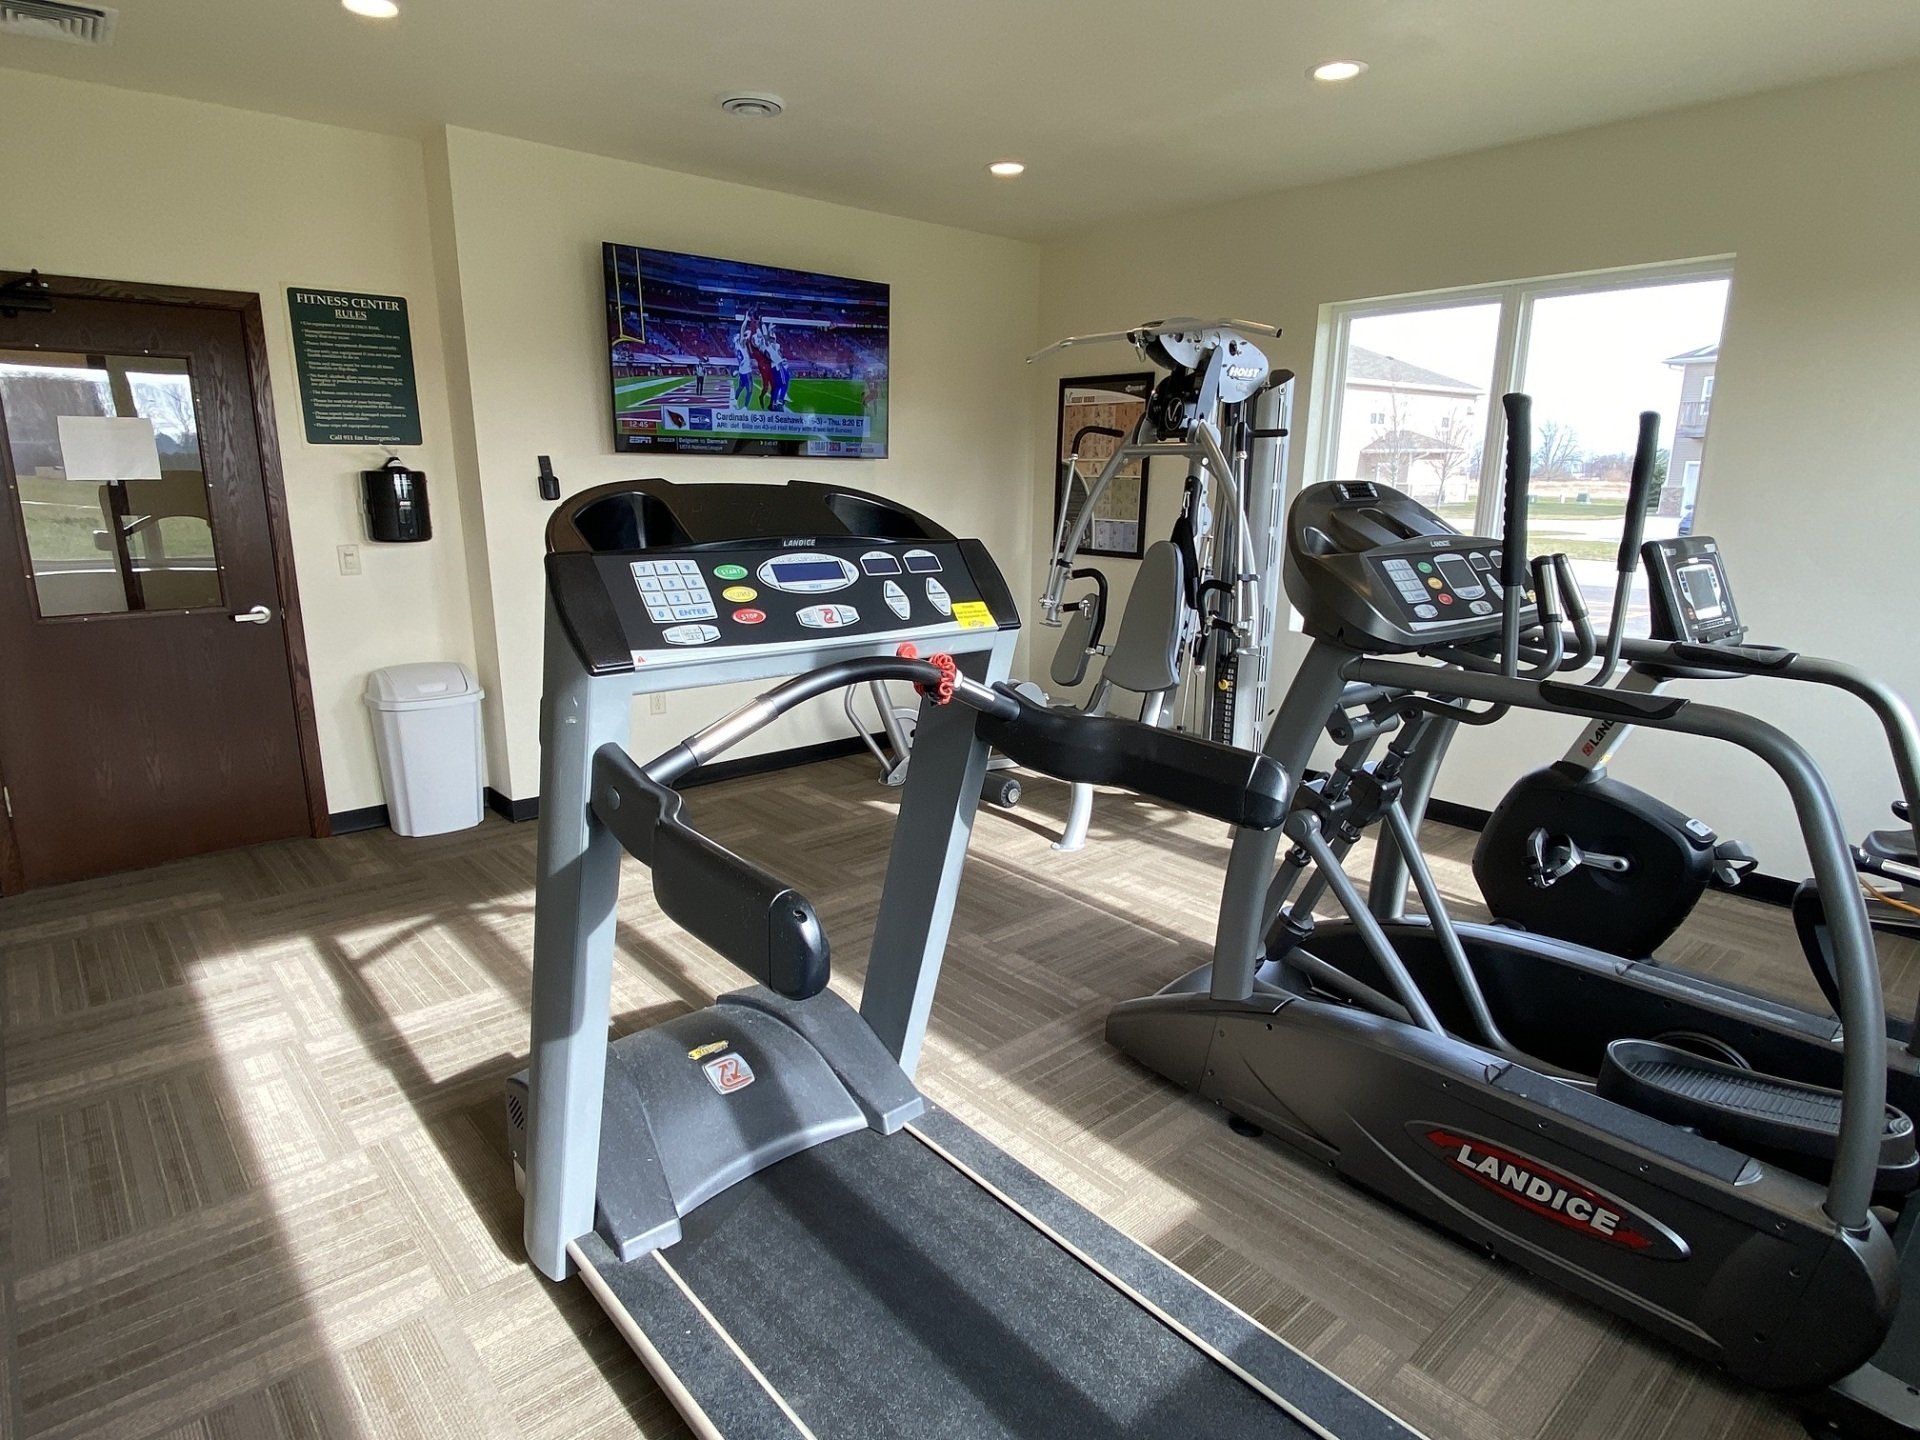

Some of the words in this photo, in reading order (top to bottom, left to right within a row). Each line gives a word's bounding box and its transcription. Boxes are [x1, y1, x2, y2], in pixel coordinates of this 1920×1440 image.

[295, 293, 349, 307] FITNESS
[351, 298, 400, 312] CENTER
[334, 309, 367, 320] RULES
[1229, 367, 1260, 378] HOIST
[716, 412, 749, 422] Cardinals
[775, 415, 806, 424] Seahawk
[629, 436, 652, 444] ESPN
[783, 539, 816, 547] LANDICE
[720, 568, 741, 576] START
[678, 608, 709, 616] ENTER
[1457, 1144, 1620, 1235] LANDICE
